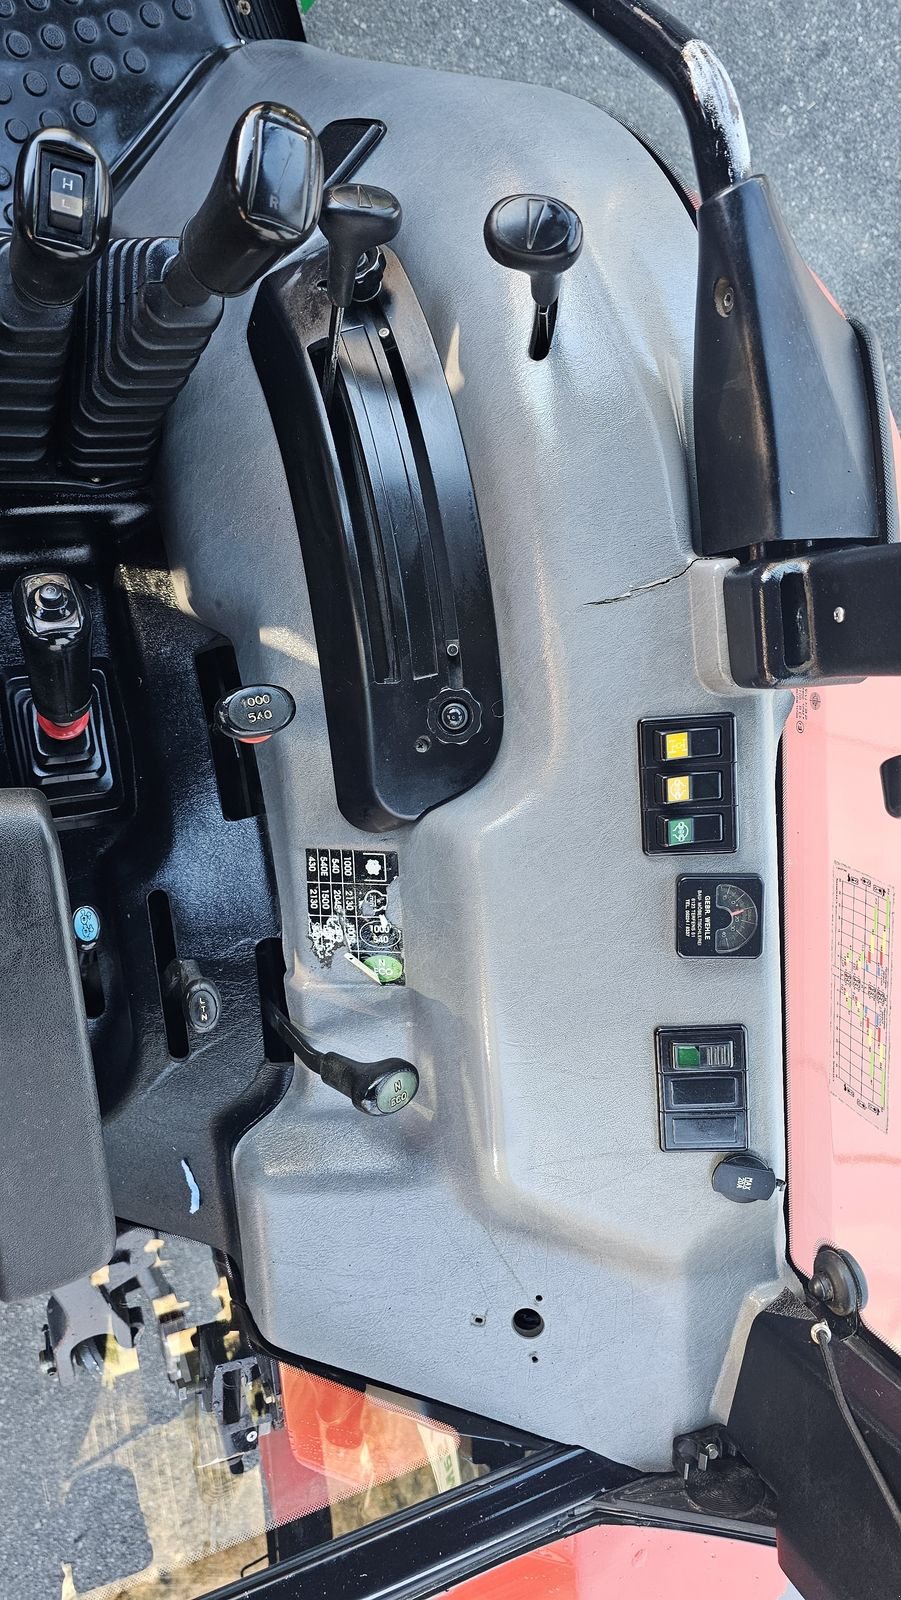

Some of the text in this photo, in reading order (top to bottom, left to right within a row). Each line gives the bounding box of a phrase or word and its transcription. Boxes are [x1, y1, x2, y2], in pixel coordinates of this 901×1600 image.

[62, 178, 73, 191] H
[61, 199, 70, 209] L
[269, 195, 280, 210] R
[248, 710, 272, 723] 540
[332, 858, 340, 874] 540
[344, 856, 352, 876] 1000
[308, 856, 318, 909] 430 2130
[320, 856, 330, 910] 540E 1500
[345, 890, 354, 910] 2130
[394, 1080, 402, 1092] N
[390, 1091, 407, 1107] ECO
